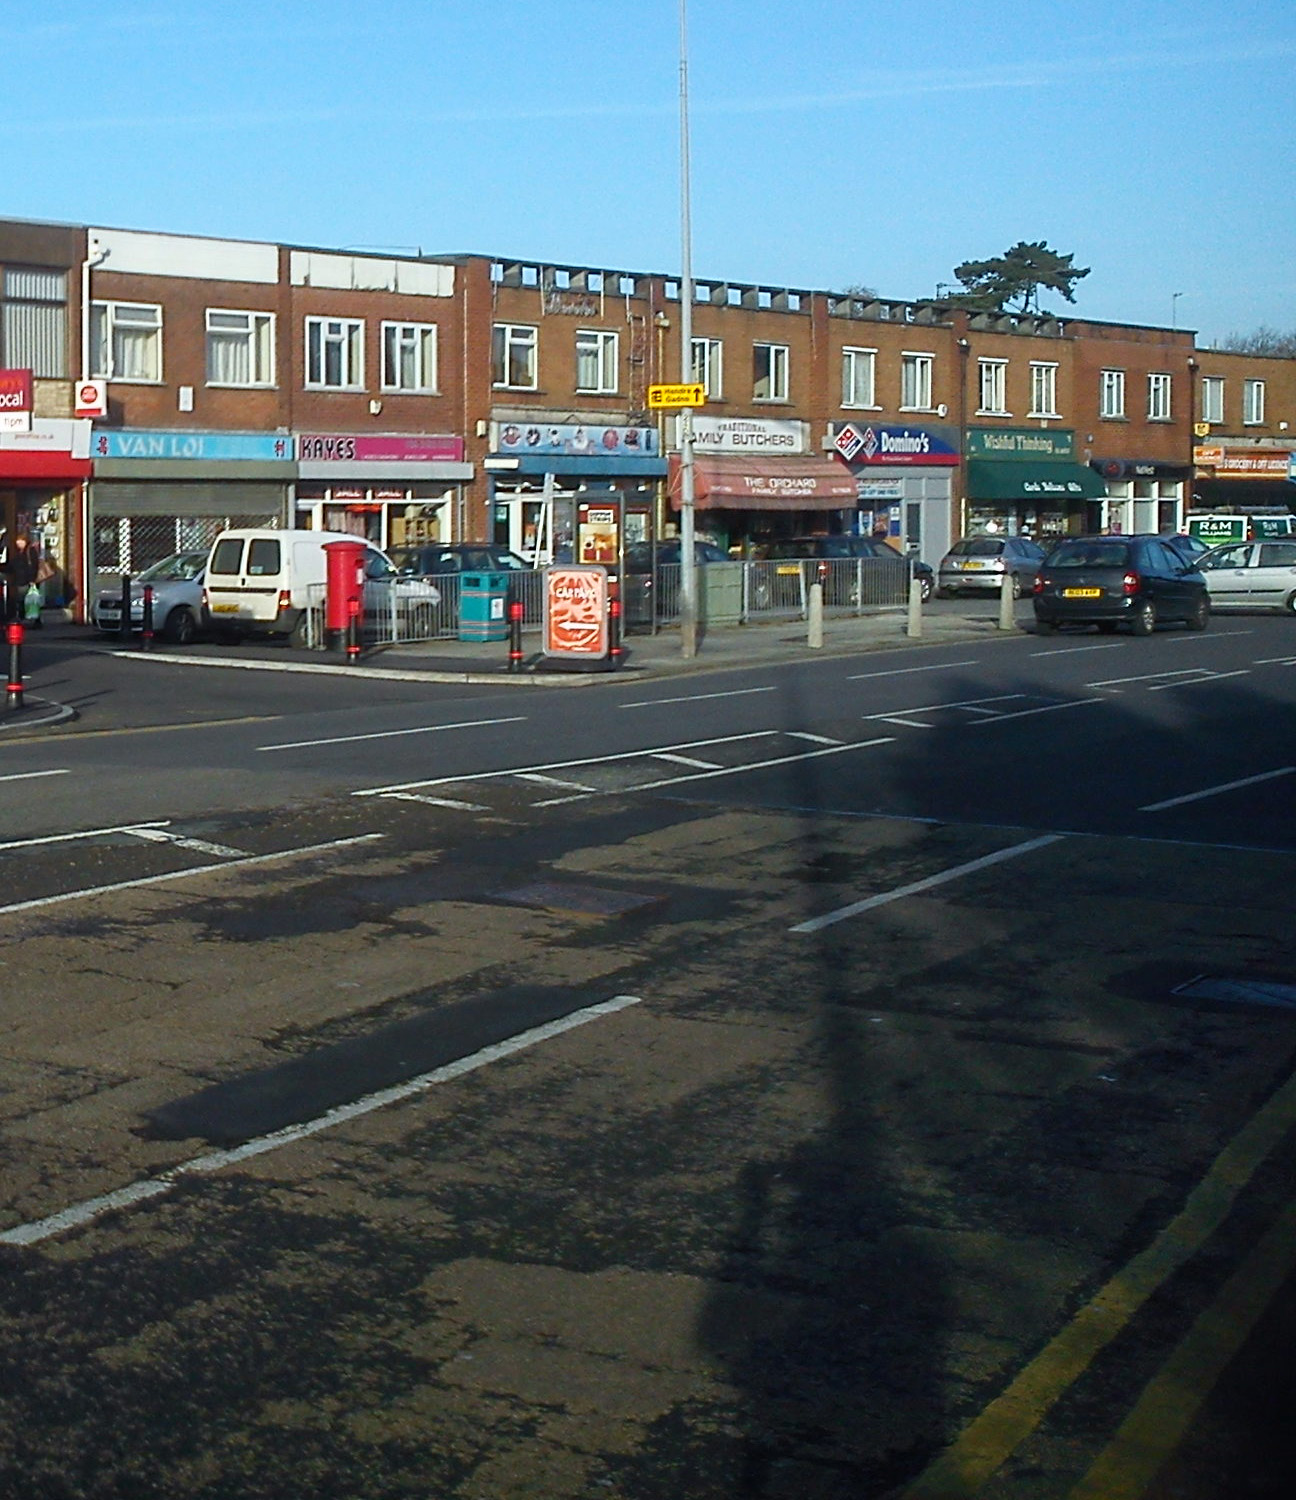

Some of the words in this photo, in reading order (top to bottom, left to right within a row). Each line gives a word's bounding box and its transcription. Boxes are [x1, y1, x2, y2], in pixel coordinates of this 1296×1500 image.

[718, 422, 767, 433] TRADITIONAL
[117, 435, 164, 456] VAN
[681, 432, 725, 446] AMILY
[732, 434, 794, 446] BUTCHERS
[881, 431, 929, 453] Domino's
[984, 434, 1015, 450] Wishful
[1016, 435, 1053, 454] Thinking
[301, 437, 356, 460] KAYES
[743, 477, 764, 488] THE
[769, 478, 817, 489] ORCHARD
[1200, 521, 1232, 530] R&M
[556, 587, 575, 598] CAR
